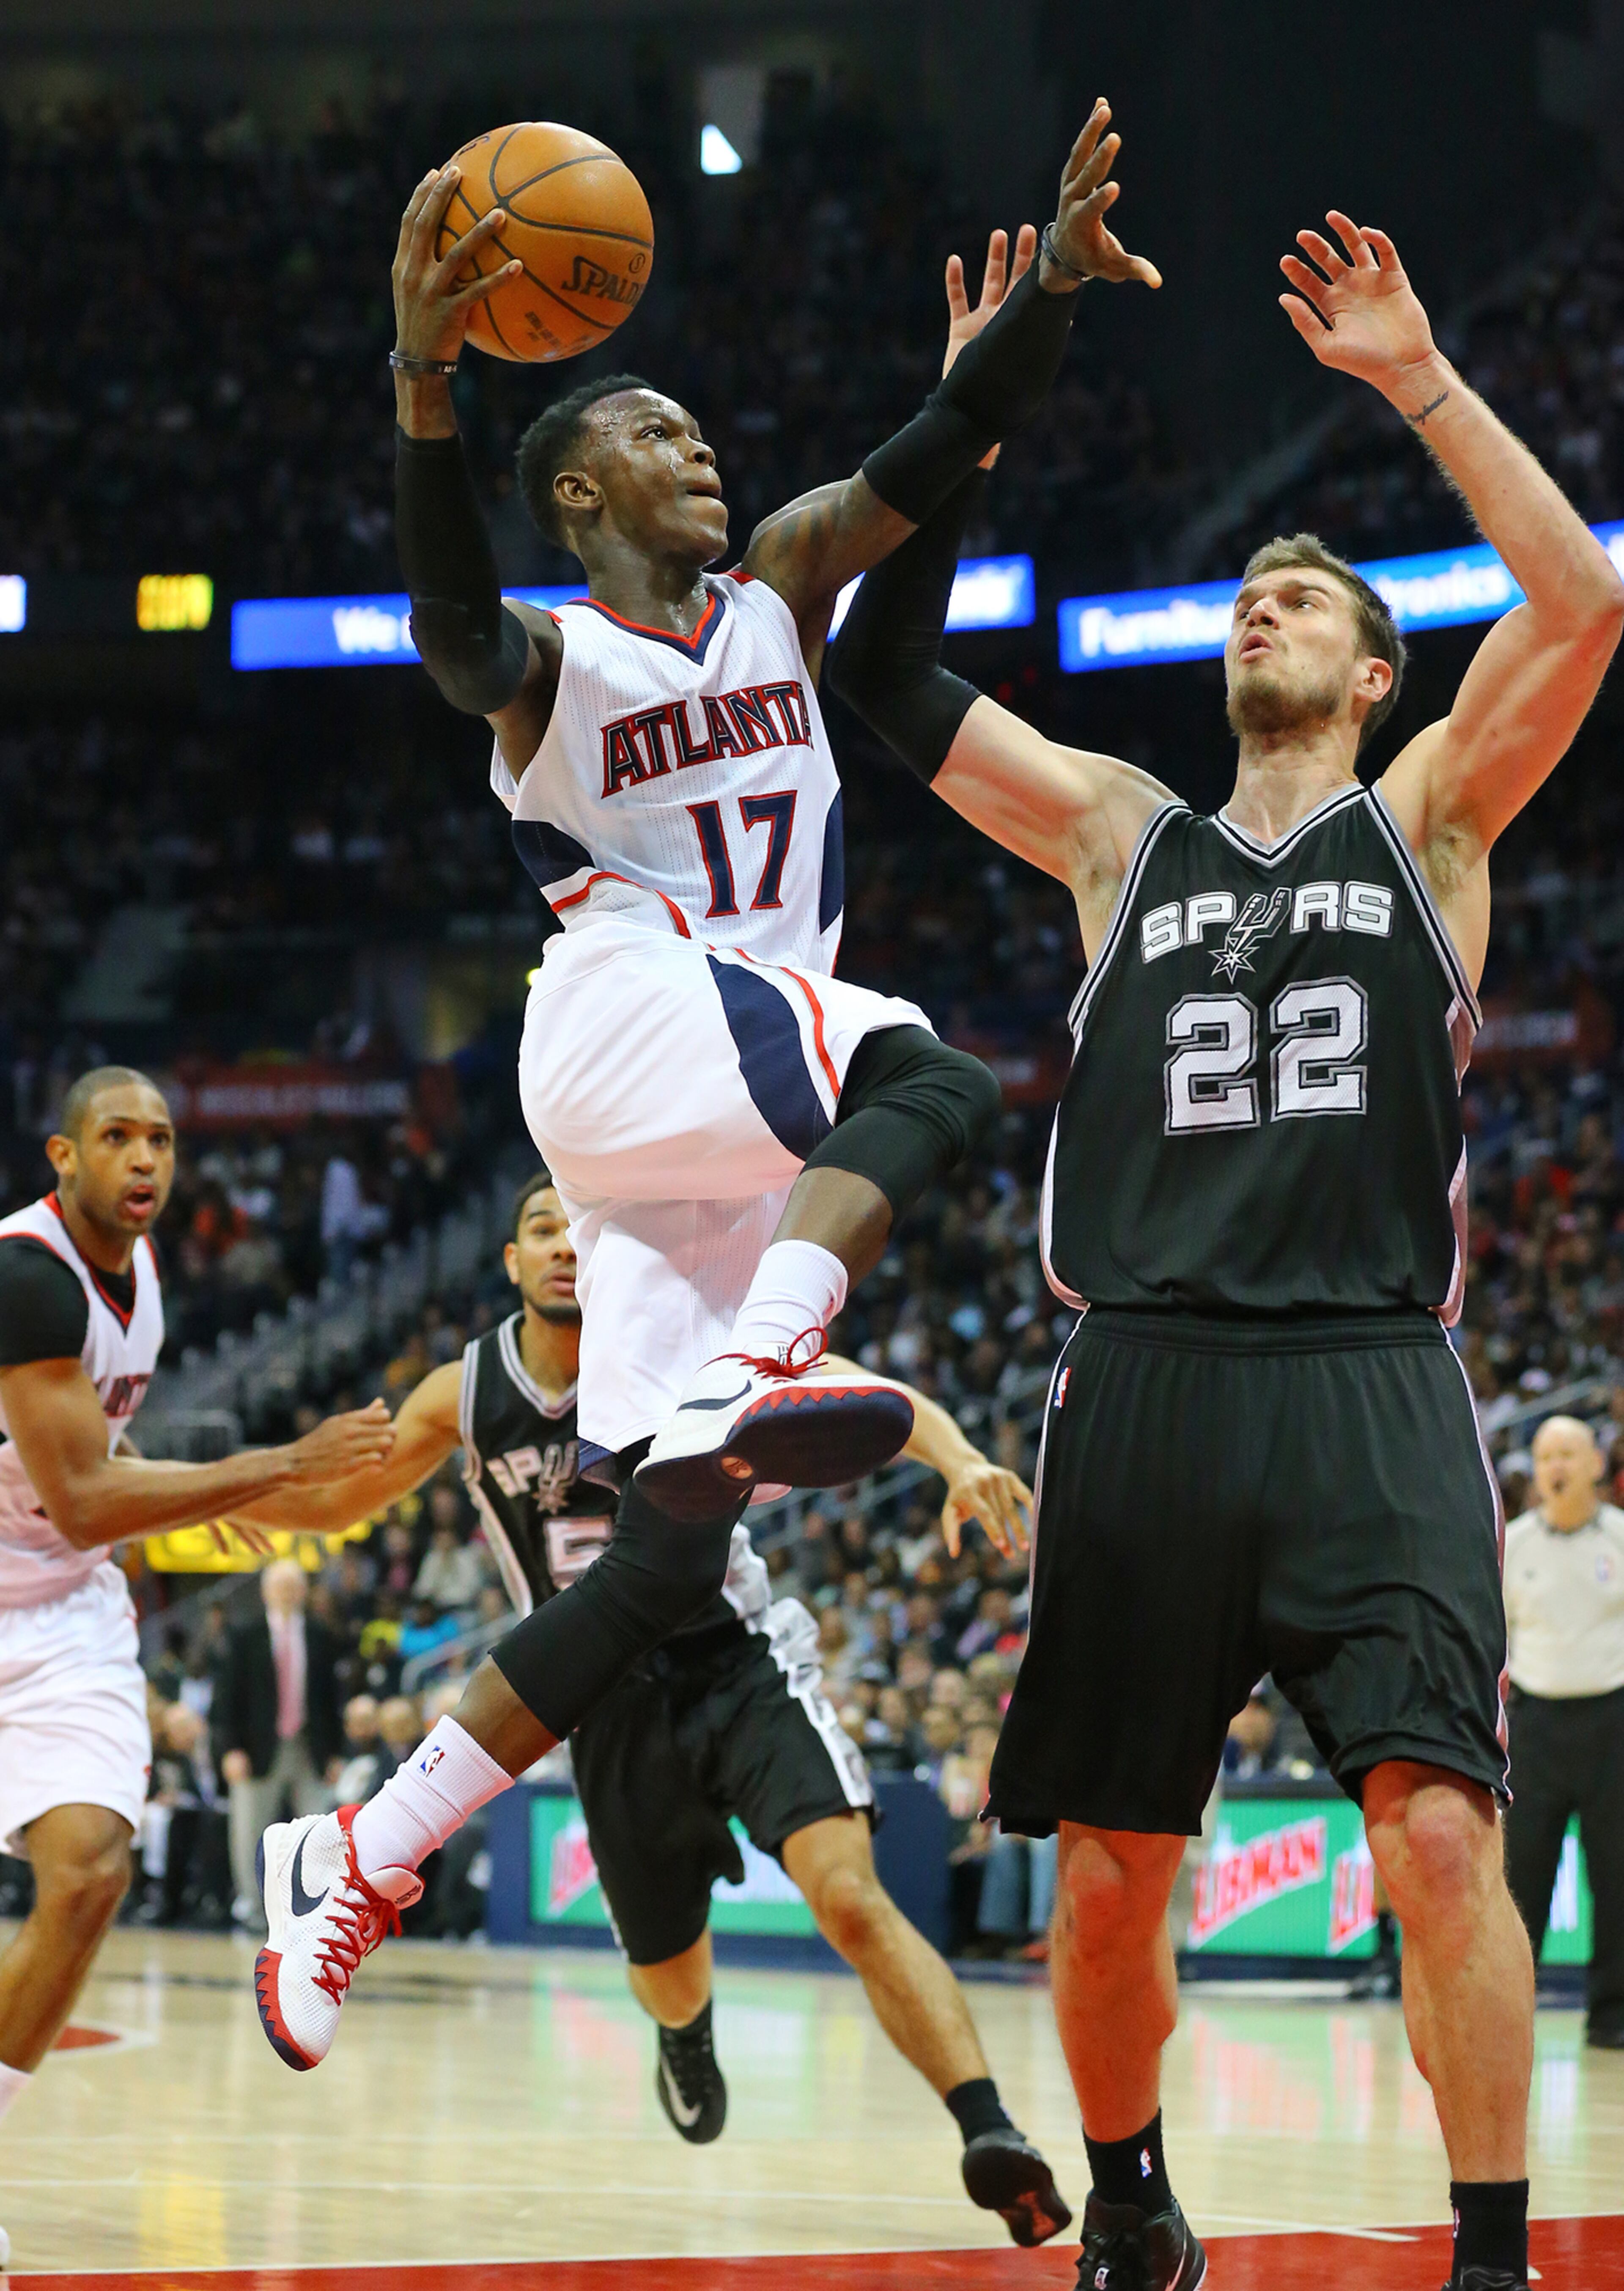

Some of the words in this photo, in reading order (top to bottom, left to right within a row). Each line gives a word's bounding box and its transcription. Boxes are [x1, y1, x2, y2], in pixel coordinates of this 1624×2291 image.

[561, 255, 645, 306] SPALD
[1078, 599, 1234, 658] Furnitu
[600, 681, 815, 799] ATLANTA
[685, 790, 798, 918] 17
[1140, 880, 1396, 983] SPURS
[1164, 975, 1369, 1137] 22
